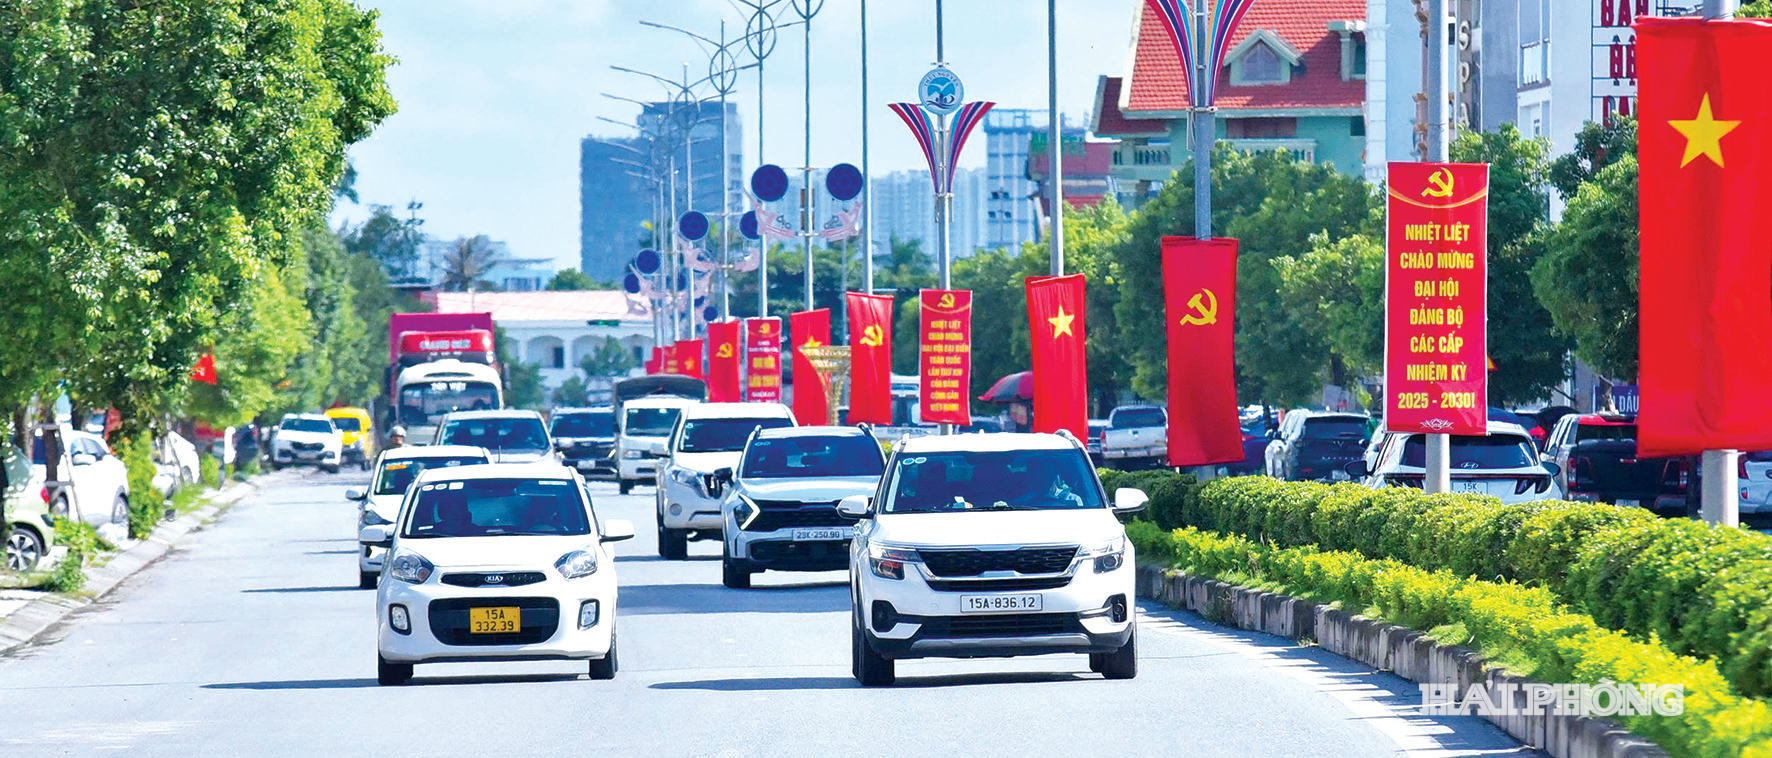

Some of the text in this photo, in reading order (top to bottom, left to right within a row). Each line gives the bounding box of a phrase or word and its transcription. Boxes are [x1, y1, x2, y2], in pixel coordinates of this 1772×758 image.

[1405, 221, 1470, 245] NHIỆT LIỆT
[1400, 249, 1474, 269] CHÀO MỪNG
[1414, 277, 1459, 300] ĐẠI HỘI
[1409, 303, 1463, 329] ĐẢNG BỘ
[1410, 330, 1464, 353] CÁC CẤP
[1407, 361, 1467, 384] NHIỆM KỲ
[1398, 392, 1429, 409] 2025
[1441, 392, 1475, 409] 2030!
[969, 597, 1035, 609] 15A-836.12
[486, 609, 505, 620] 15A
[475, 621, 514, 632] 332.39
